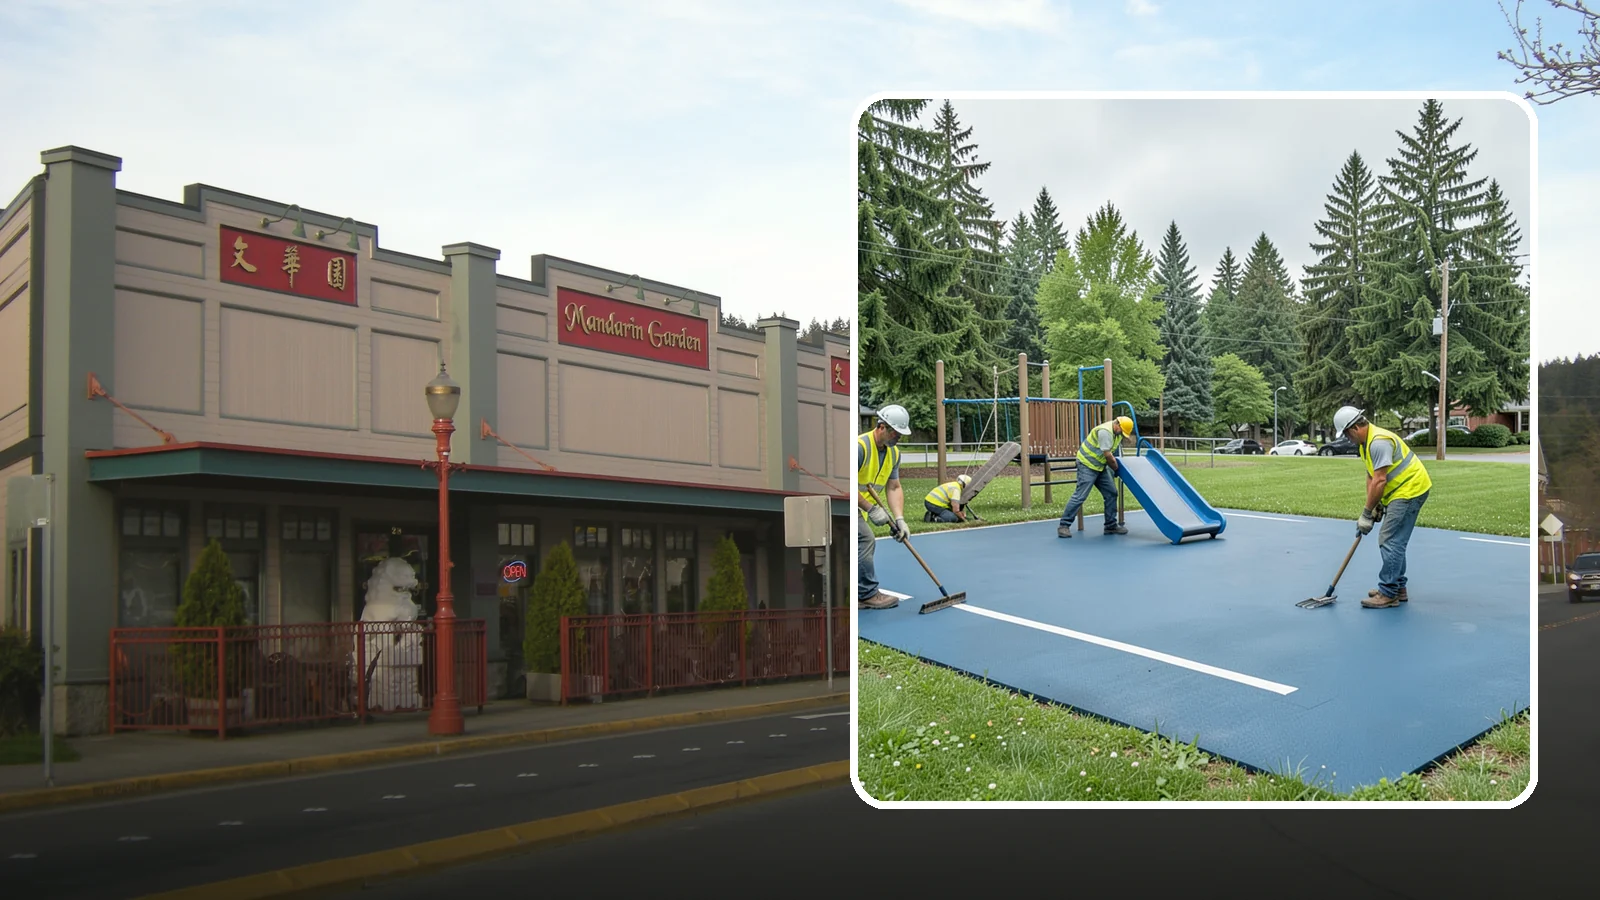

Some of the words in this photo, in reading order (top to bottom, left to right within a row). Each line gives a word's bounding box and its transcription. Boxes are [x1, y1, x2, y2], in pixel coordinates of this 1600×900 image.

[564, 302, 644, 341] Mandarin
[648, 320, 702, 352] Garden
[835, 363, 846, 386] 文
[503, 565, 527, 578] OPEN
